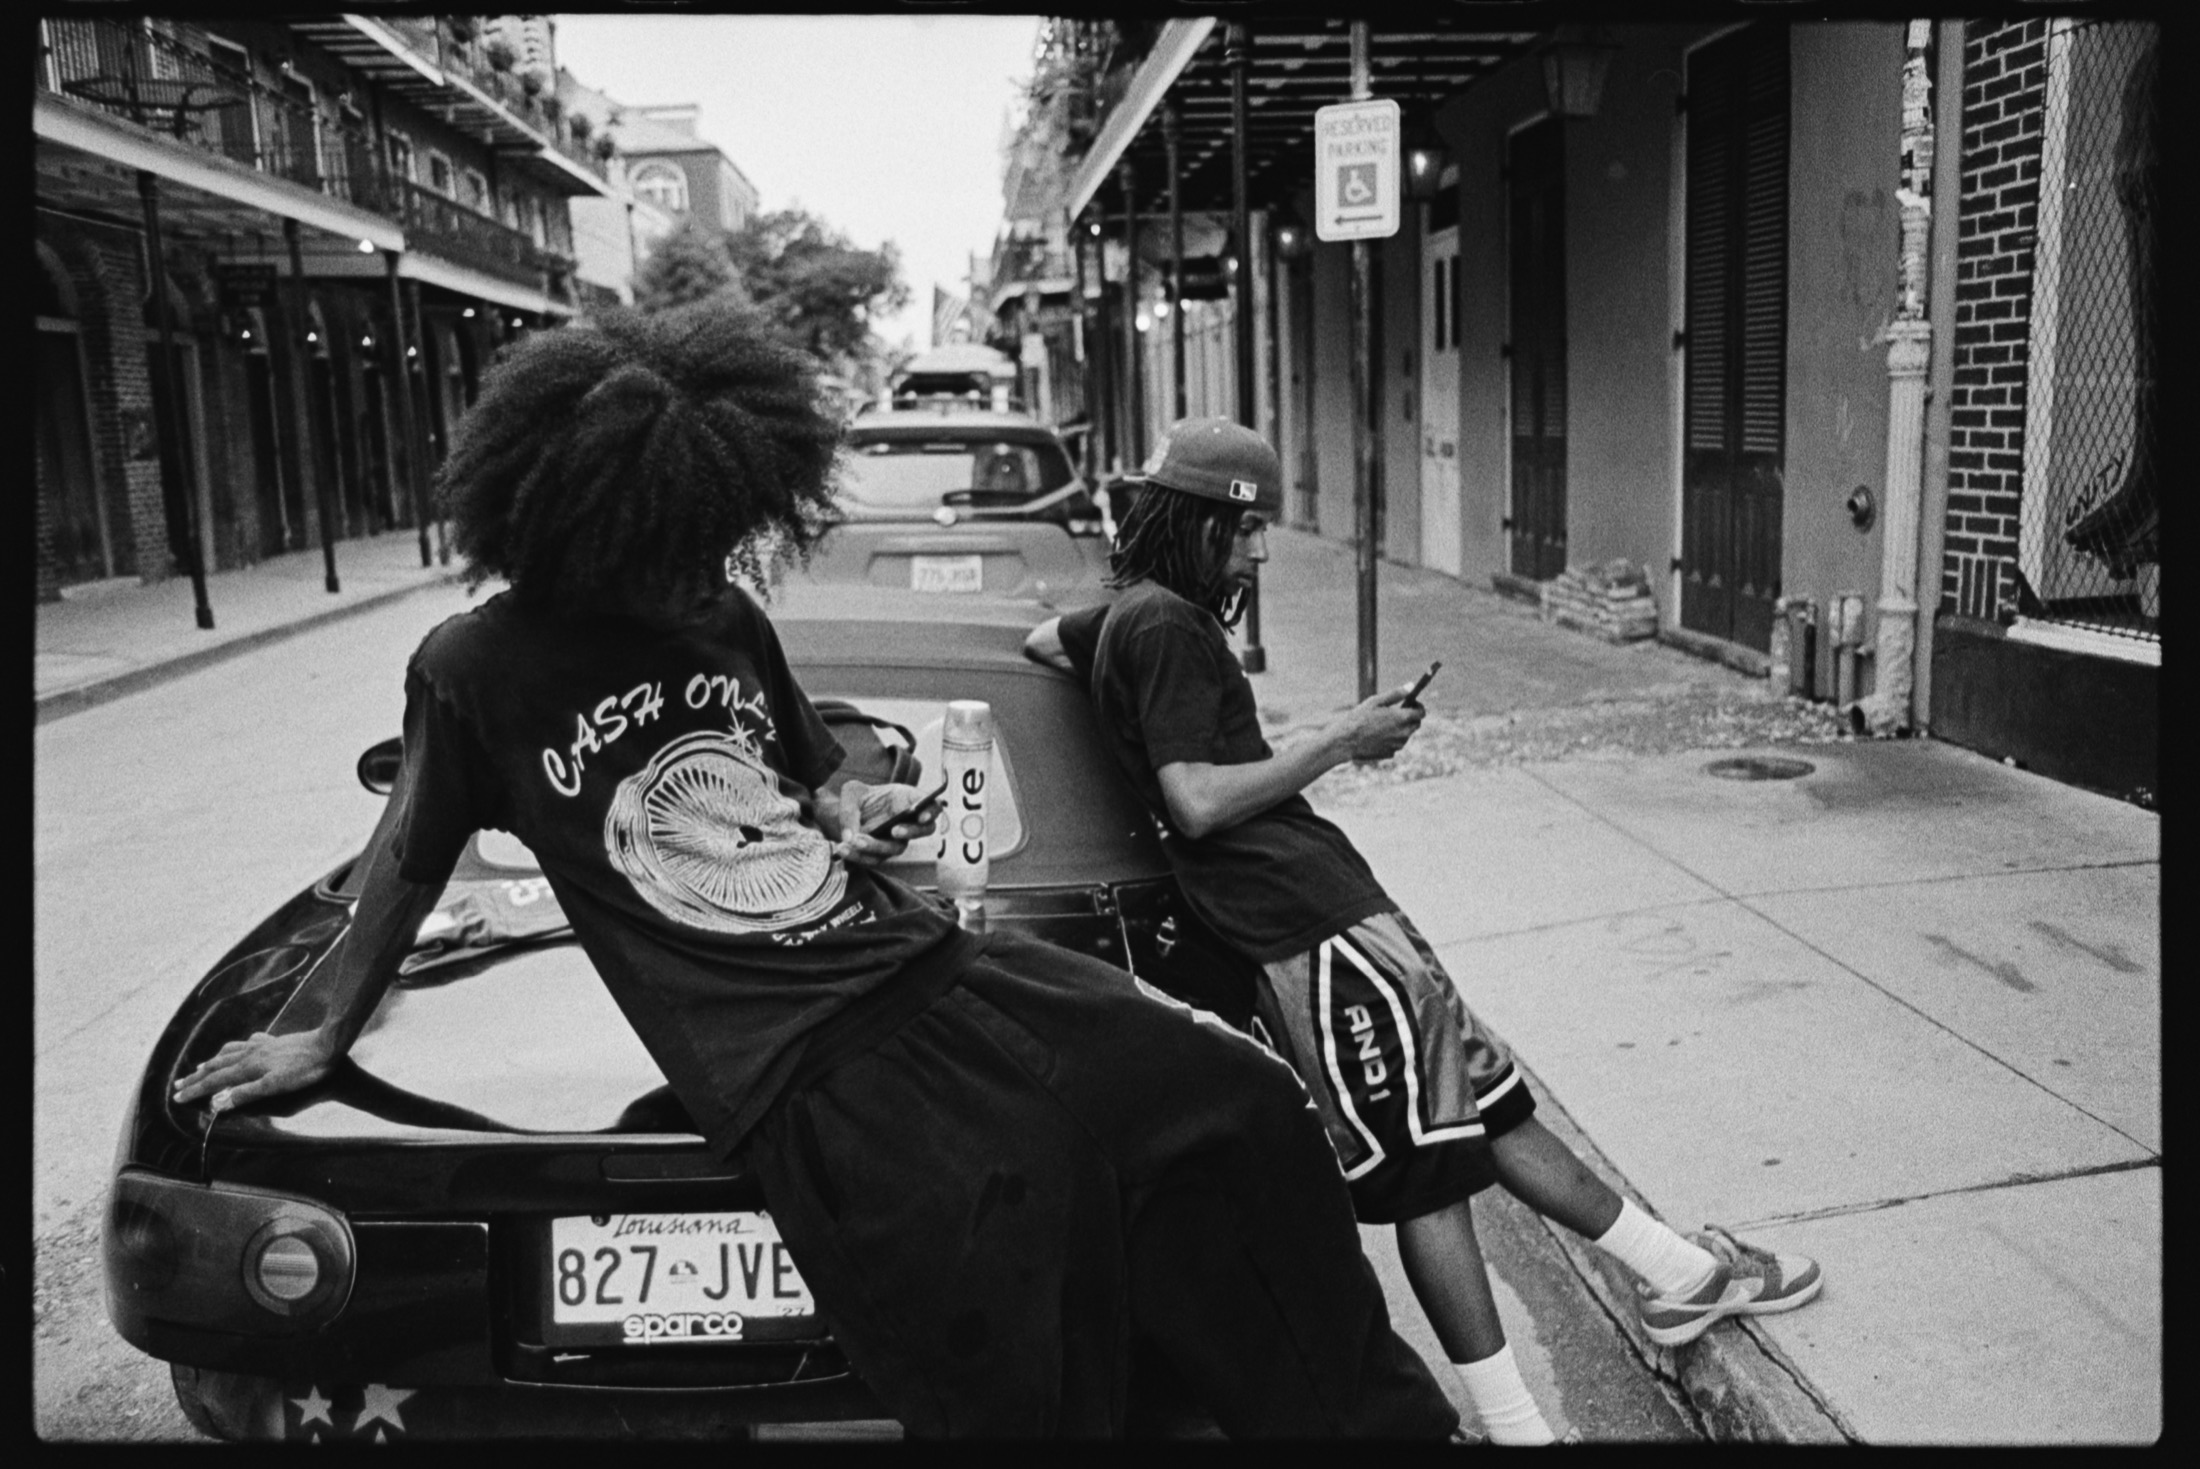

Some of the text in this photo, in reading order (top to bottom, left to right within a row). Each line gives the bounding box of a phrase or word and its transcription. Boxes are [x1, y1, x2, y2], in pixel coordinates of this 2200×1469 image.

[1324, 115, 1391, 136] RESERVED
[1328, 139, 1387, 157] PARKING
[543, 681, 664, 797] CASH
[960, 768, 985, 865] core
[613, 1214, 755, 1238] Louisiana
[558, 1242, 801, 1306] 827 JVE
[623, 1311, 743, 1344] sparco
